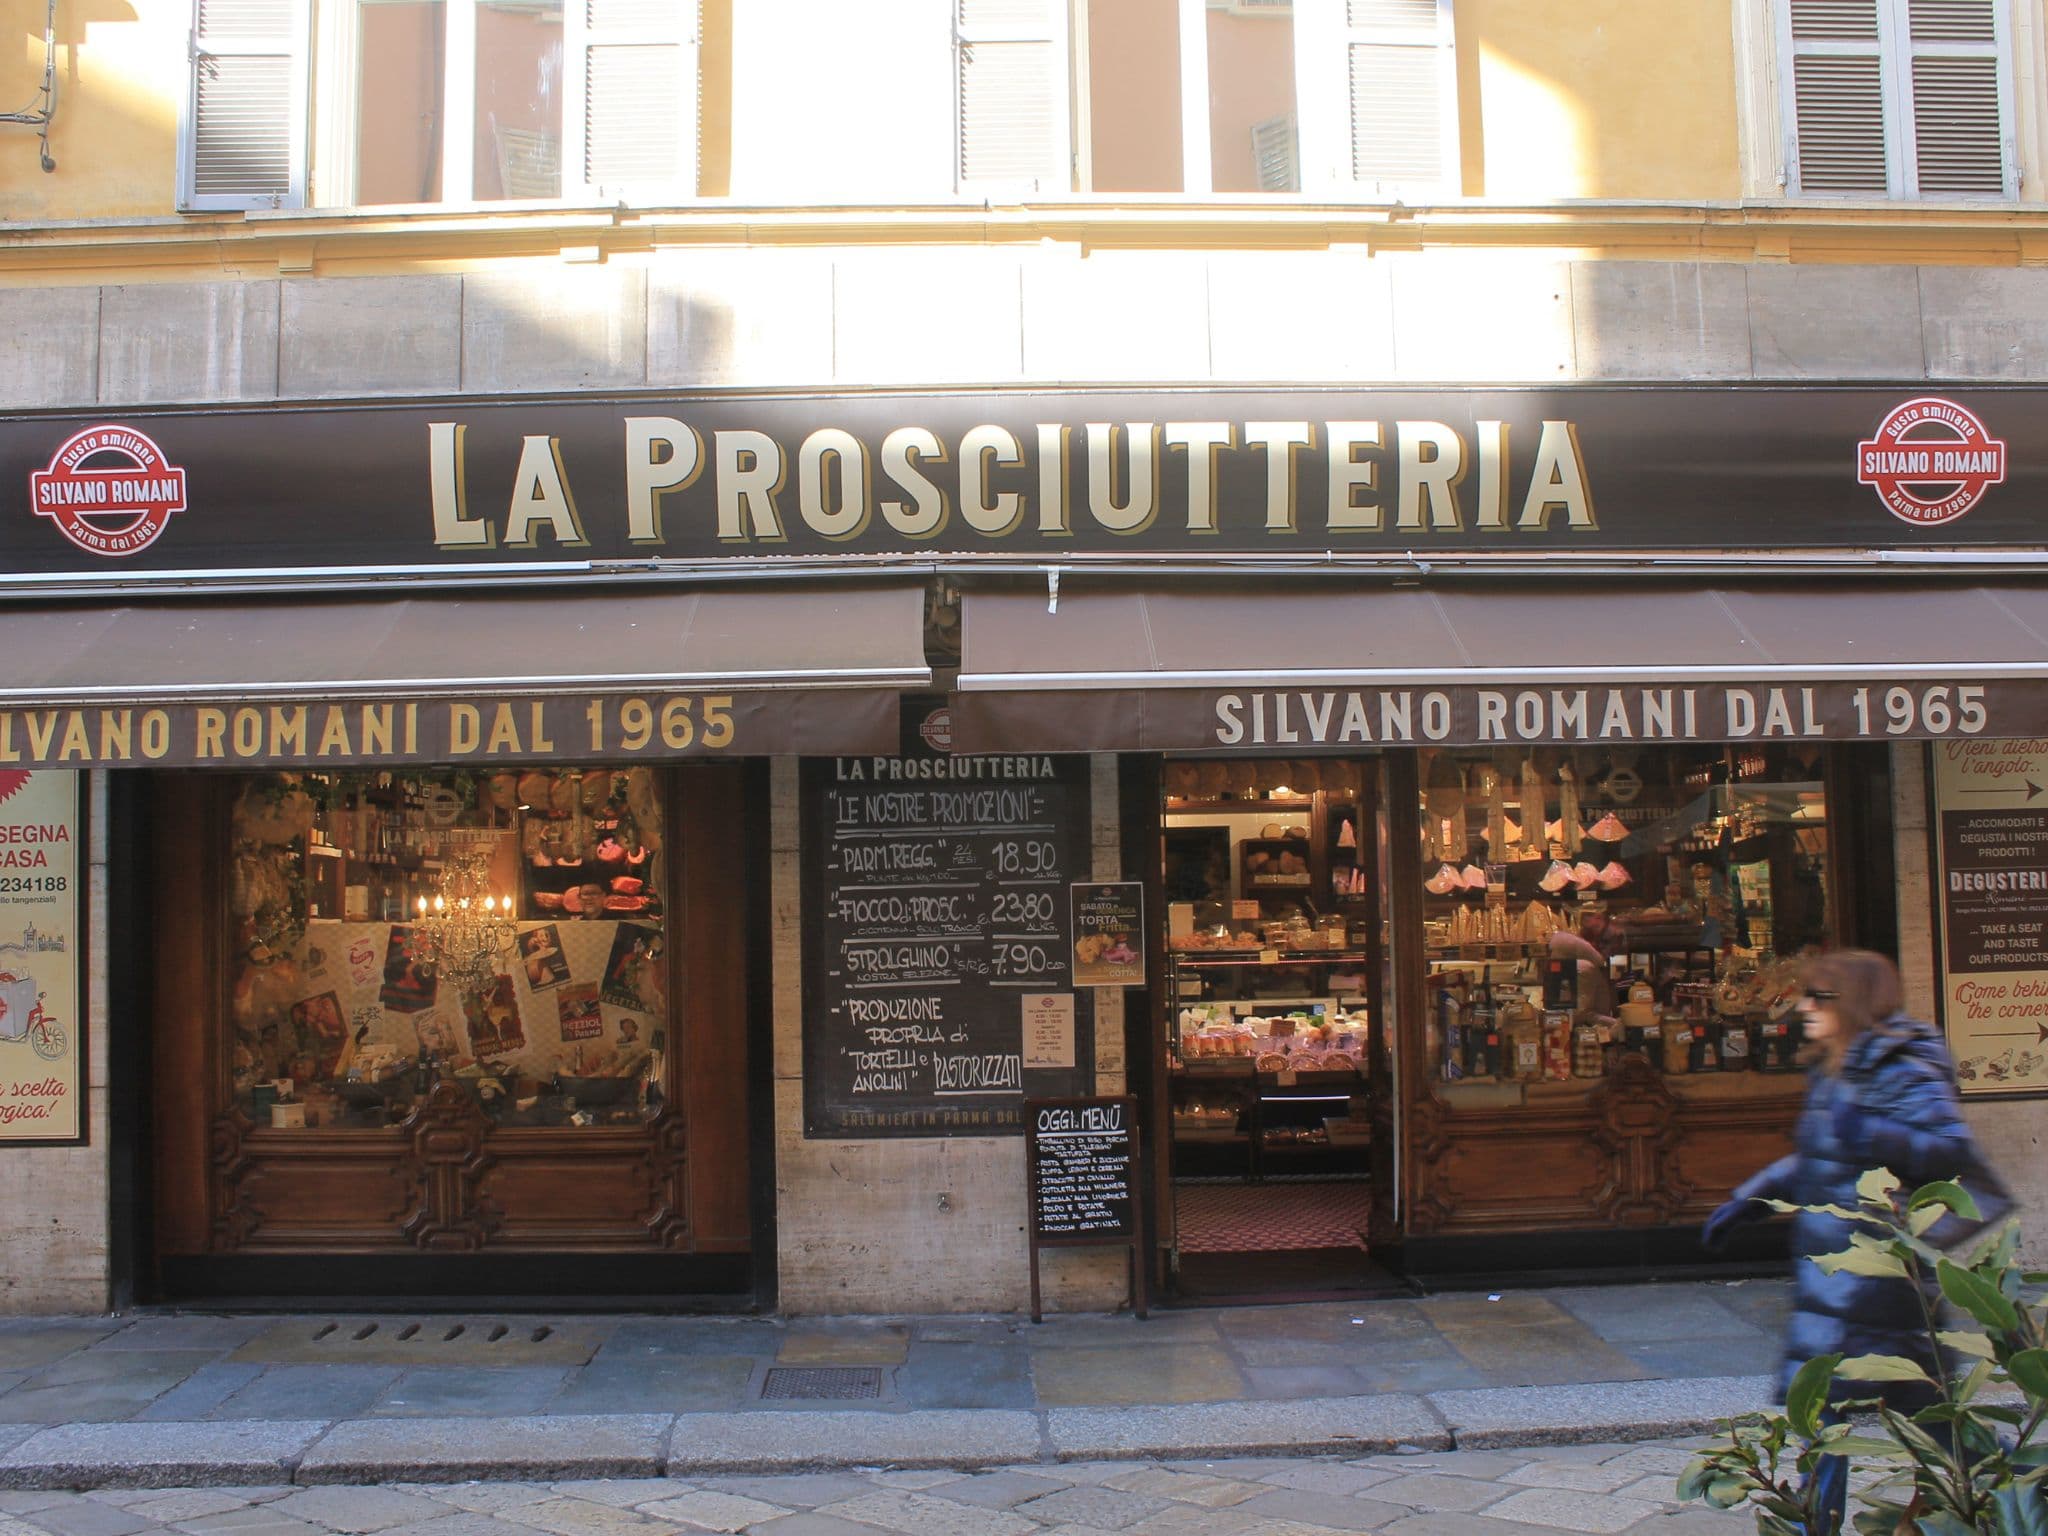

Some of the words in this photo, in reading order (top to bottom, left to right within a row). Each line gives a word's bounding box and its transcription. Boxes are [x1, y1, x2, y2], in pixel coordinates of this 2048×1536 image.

[1886, 410, 1919, 437] Gusto
[1922, 406, 1976, 437] emiliano
[62, 437, 97, 467] Gusto
[101, 433, 156, 465] emiliano
[1865, 451, 1929, 474] SILVANO
[1934, 451, 1998, 474] ROMANI
[41, 481, 107, 505] SILVANO
[112, 478, 179, 503] ROMANI
[428, 421, 591, 550] LA
[624, 416, 1603, 545] PROSCIUTTERIA
[1887, 490, 1920, 518] Parma
[1923, 507, 1942, 519] dal
[1945, 490, 1972, 515] 1965
[69, 521, 107, 548] Parma
[110, 536, 131, 550] dal
[132, 519, 158, 548] 1965
[1215, 690, 1451, 745] SILVANO
[1478, 688, 1697, 743] ROMANI
[1726, 687, 1825, 738] DAL
[1853, 686, 1988, 736] 1965
[0, 704, 171, 763] LVANO
[196, 701, 420, 759] ROMANI
[449, 699, 555, 756] DAL
[586, 695, 736, 754] 1965
[836, 757, 865, 780] LA
[873, 756, 1055, 780] PROSCIUTTERIA
[866, 792, 928, 824] NOSTRE
[2038, 817, 2046, 827] E
[0, 824, 70, 844] SEGNA
[1960, 834, 2007, 844] DEGUSTA
[0, 850, 48, 868] ASA
[1978, 847, 2030, 858] PRODOTTI
[0, 876, 67, 893] 234188
[1080, 902, 1112, 911] SABATO
[1079, 915, 1119, 925] TORTA
[2008, 924, 2017, 934] A
[2018, 923, 2043, 934] SEAT
[1983, 939, 2006, 949] AND
[2008, 938, 2039, 949] TASTE
[1969, 954, 1993, 965] OUR
[1993, 952, 2048, 964] PRODUCTS
[1956, 981, 2006, 1005] Come
[1967, 1001, 1993, 1020] the
[865, 1025, 945, 1046] PROPRIA
[920, 1055, 930, 1066] e
[934, 1050, 1023, 1090] PASTORIZZATI
[11, 1077, 68, 1097] scelta
[943, 1109, 989, 1125] PARMA
[996, 1108, 1022, 1124] DAL
